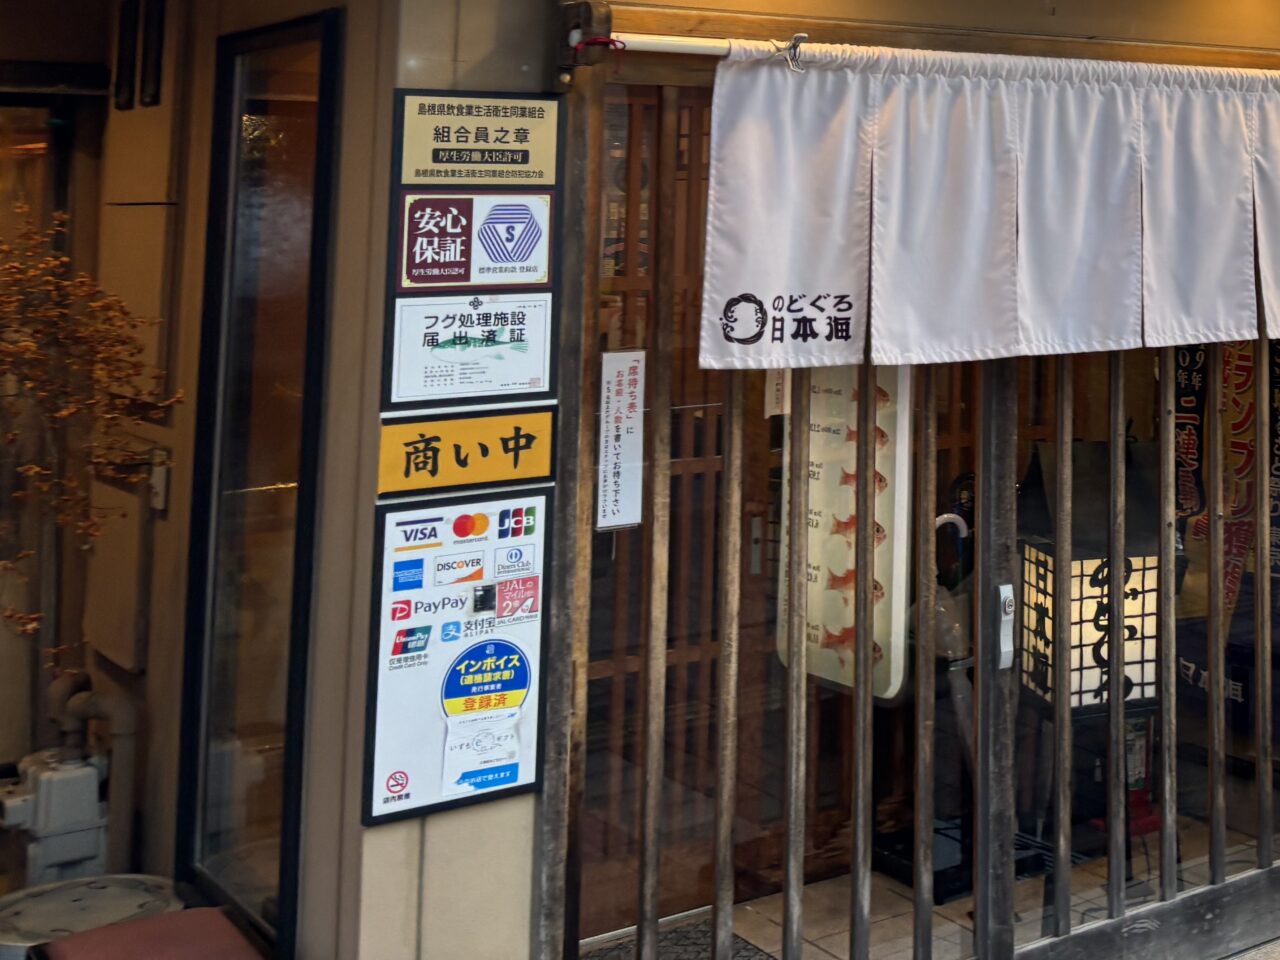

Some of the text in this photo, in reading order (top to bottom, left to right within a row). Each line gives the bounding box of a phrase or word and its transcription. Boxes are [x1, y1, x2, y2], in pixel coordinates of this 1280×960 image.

[433, 125, 531, 145] 組合員之章
[414, 207, 468, 234] 安心
[505, 225, 516, 243] S
[412, 236, 468, 264] 保証
[772, 293, 853, 313] のどぐろ
[424, 311, 526, 330] フグ処理施設
[771, 315, 852, 344] 日本海
[422, 328, 526, 347] 届出済証
[403, 427, 538, 479] 商い中
[498, 515, 535, 530] JCB
[402, 526, 438, 542] VISA
[436, 558, 482, 572] DISCOVER
[414, 596, 468, 614] PayPay
[463, 617, 496, 632] 支付宝
[456, 654, 520, 674] インボイス
[463, 693, 508, 712] 登録済
